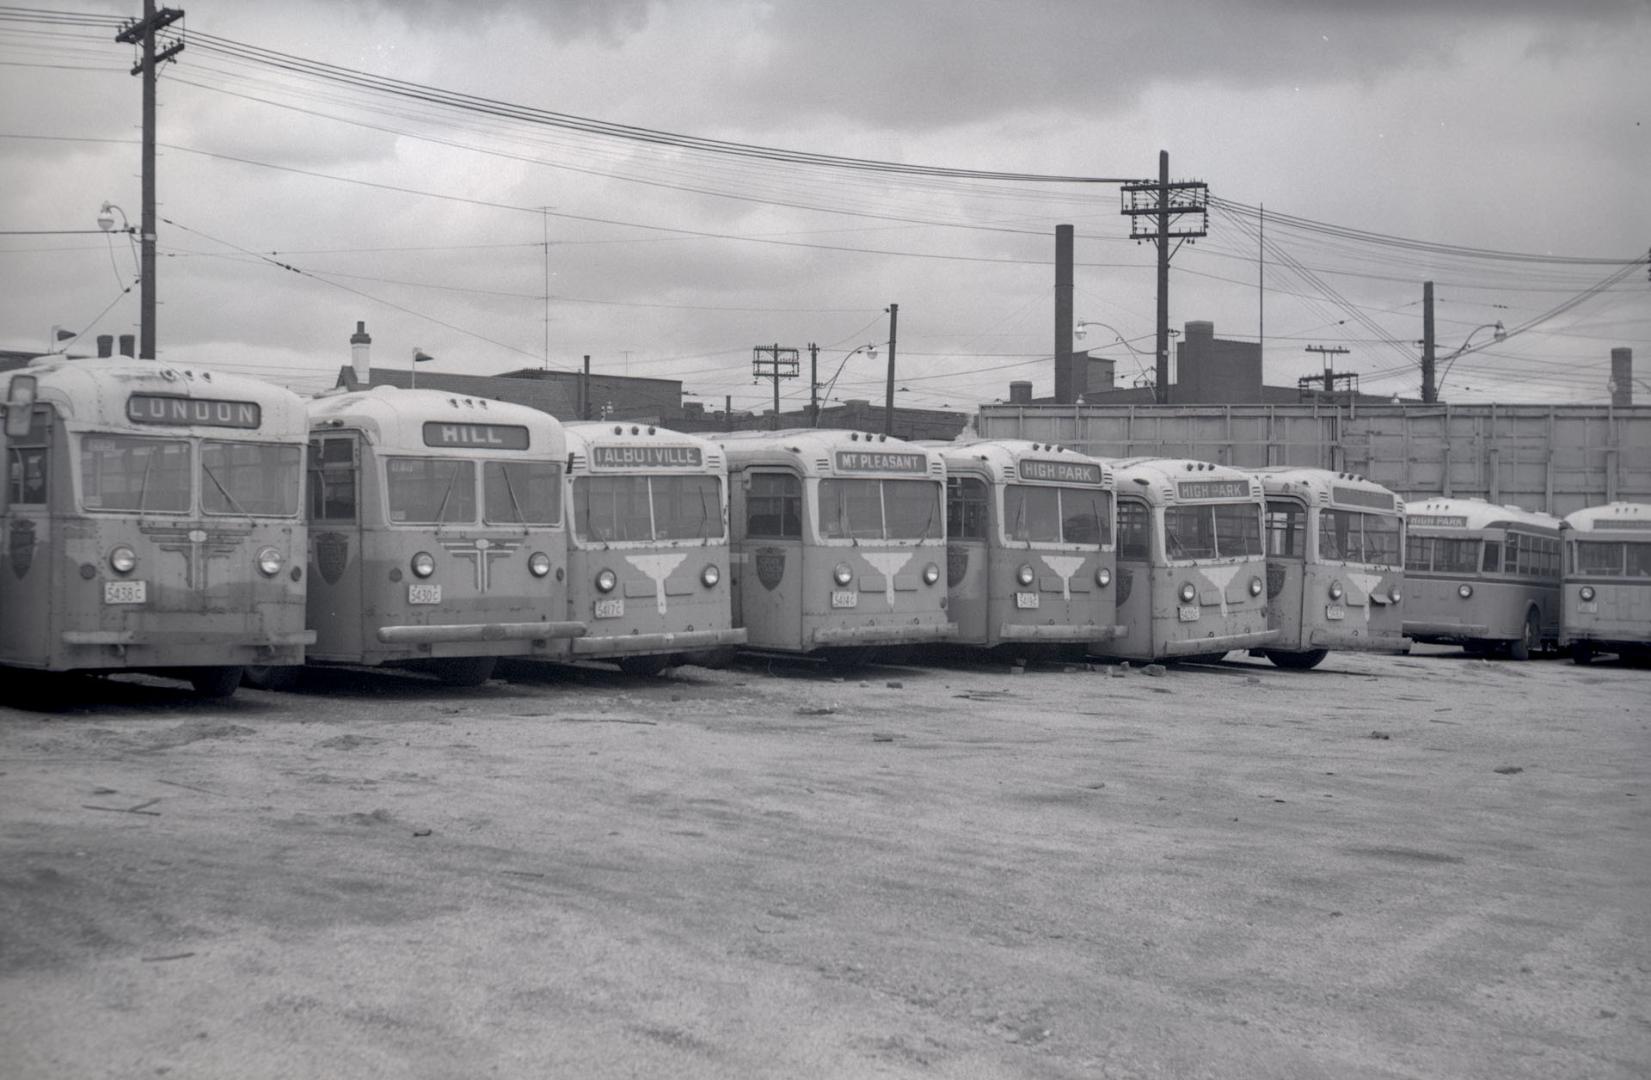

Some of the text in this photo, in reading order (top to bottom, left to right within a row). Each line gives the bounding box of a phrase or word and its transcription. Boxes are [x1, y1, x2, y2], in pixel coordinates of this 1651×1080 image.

[129, 399, 254, 423] LONDON
[441, 424, 502, 443] HILL
[861, 454, 918, 469] PLEASANT
[1025, 463, 1091, 481] HIGH PARK
[1182, 484, 1209, 497] HIGH
